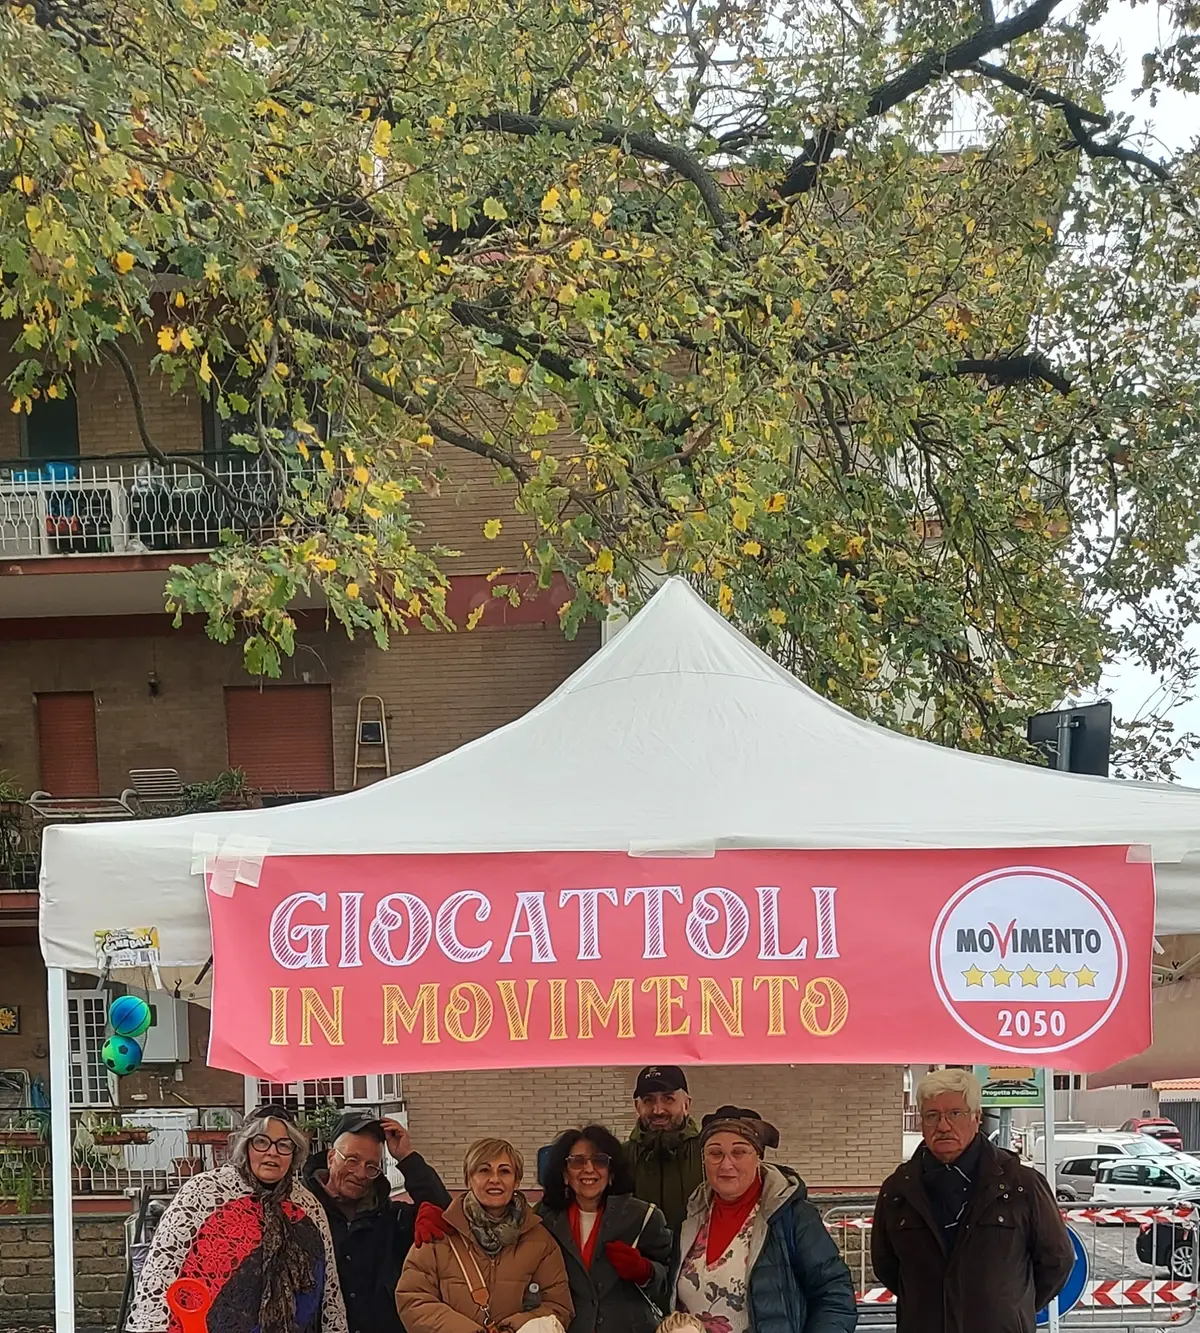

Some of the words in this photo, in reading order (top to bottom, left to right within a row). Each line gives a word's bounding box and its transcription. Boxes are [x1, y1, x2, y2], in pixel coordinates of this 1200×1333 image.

[269, 886, 841, 969] GIOCATTOLI
[956, 918, 1102, 959] MOVIMENTO
[269, 986, 346, 1046] IN
[381, 975, 850, 1046] MOVIMENTO
[997, 1009, 1066, 1037] 2050
